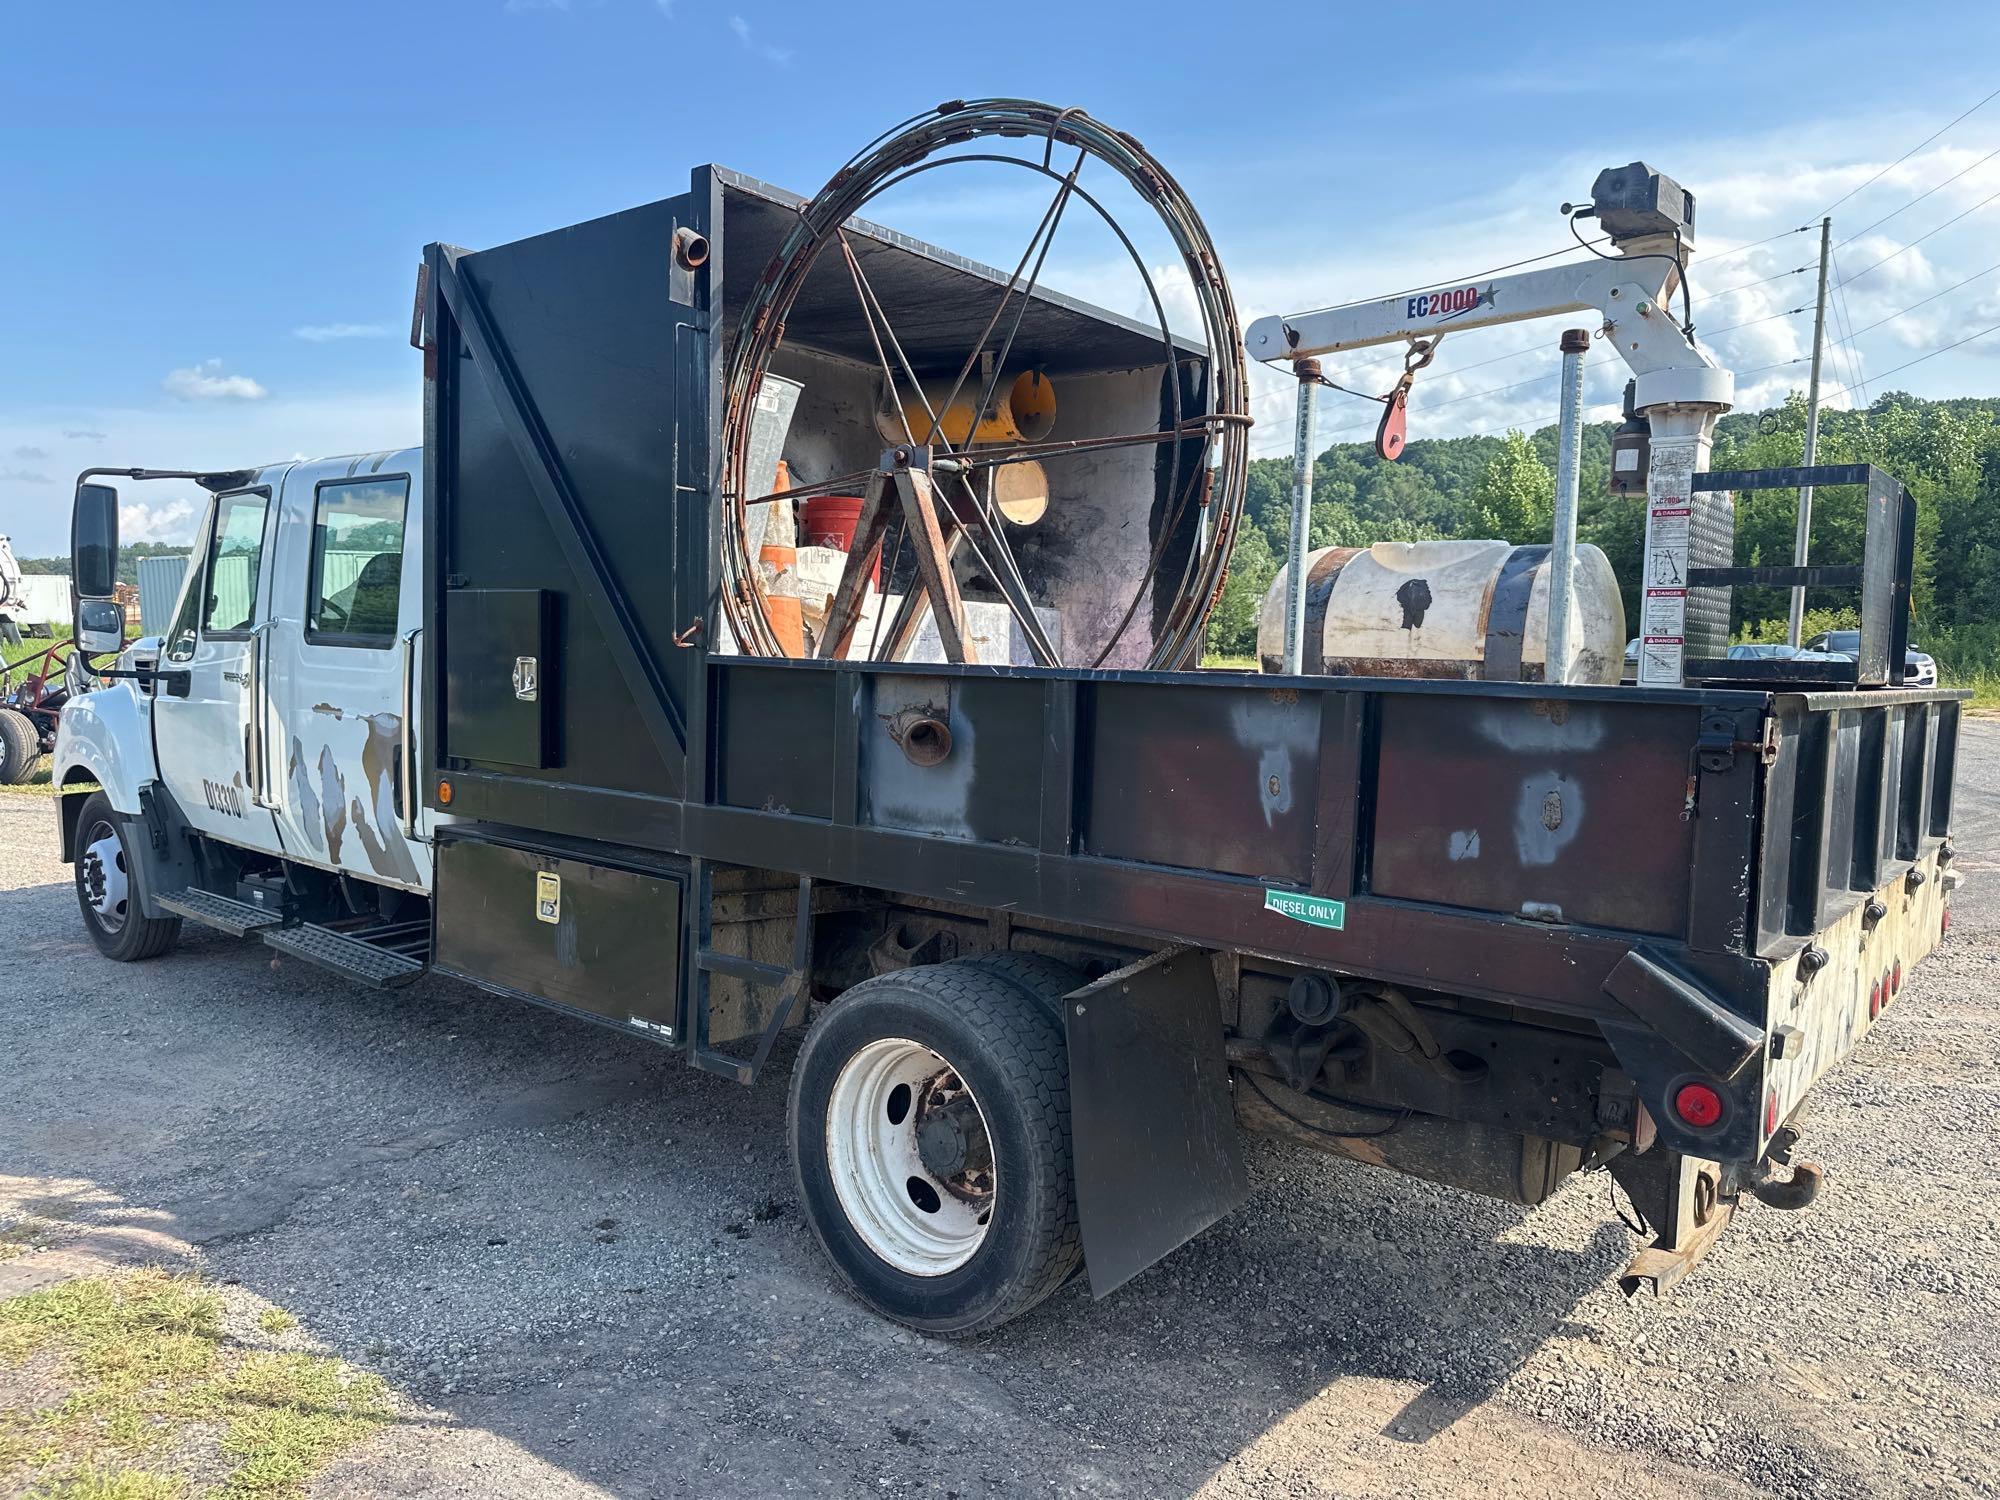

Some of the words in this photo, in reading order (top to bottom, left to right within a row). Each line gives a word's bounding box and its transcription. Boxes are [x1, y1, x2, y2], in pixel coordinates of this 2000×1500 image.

[1407, 287, 1478, 319] EC2000
[203, 778, 241, 819] D13310
[1272, 898, 1306, 915] DIESEL
[1308, 904, 1337, 920] ONLY
